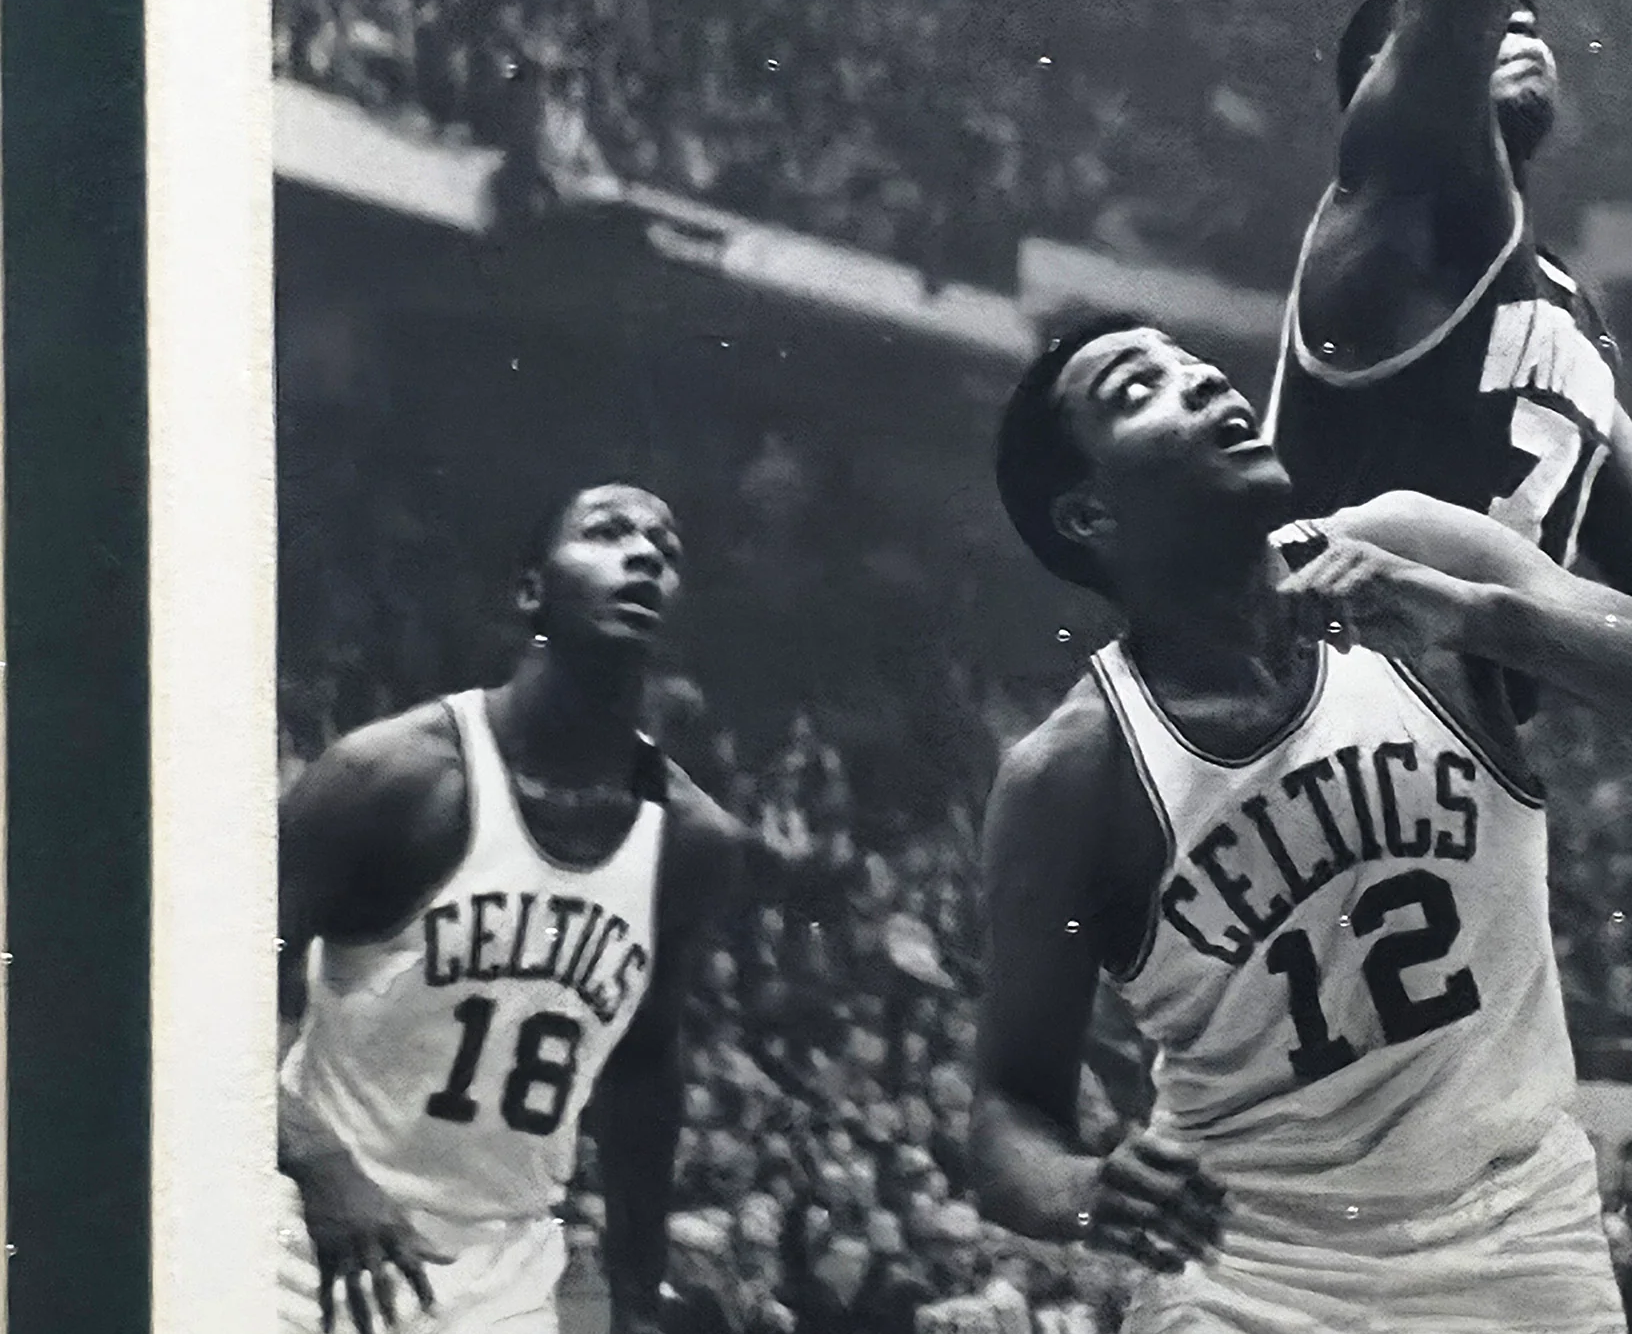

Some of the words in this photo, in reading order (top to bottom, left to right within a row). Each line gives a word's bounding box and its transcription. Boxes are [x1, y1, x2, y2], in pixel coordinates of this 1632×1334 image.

[1162, 742, 1478, 966] CELTICS
[423, 891, 647, 1024] CELTICS
[1266, 868, 1481, 1080] 12
[425, 993, 582, 1136] 18
